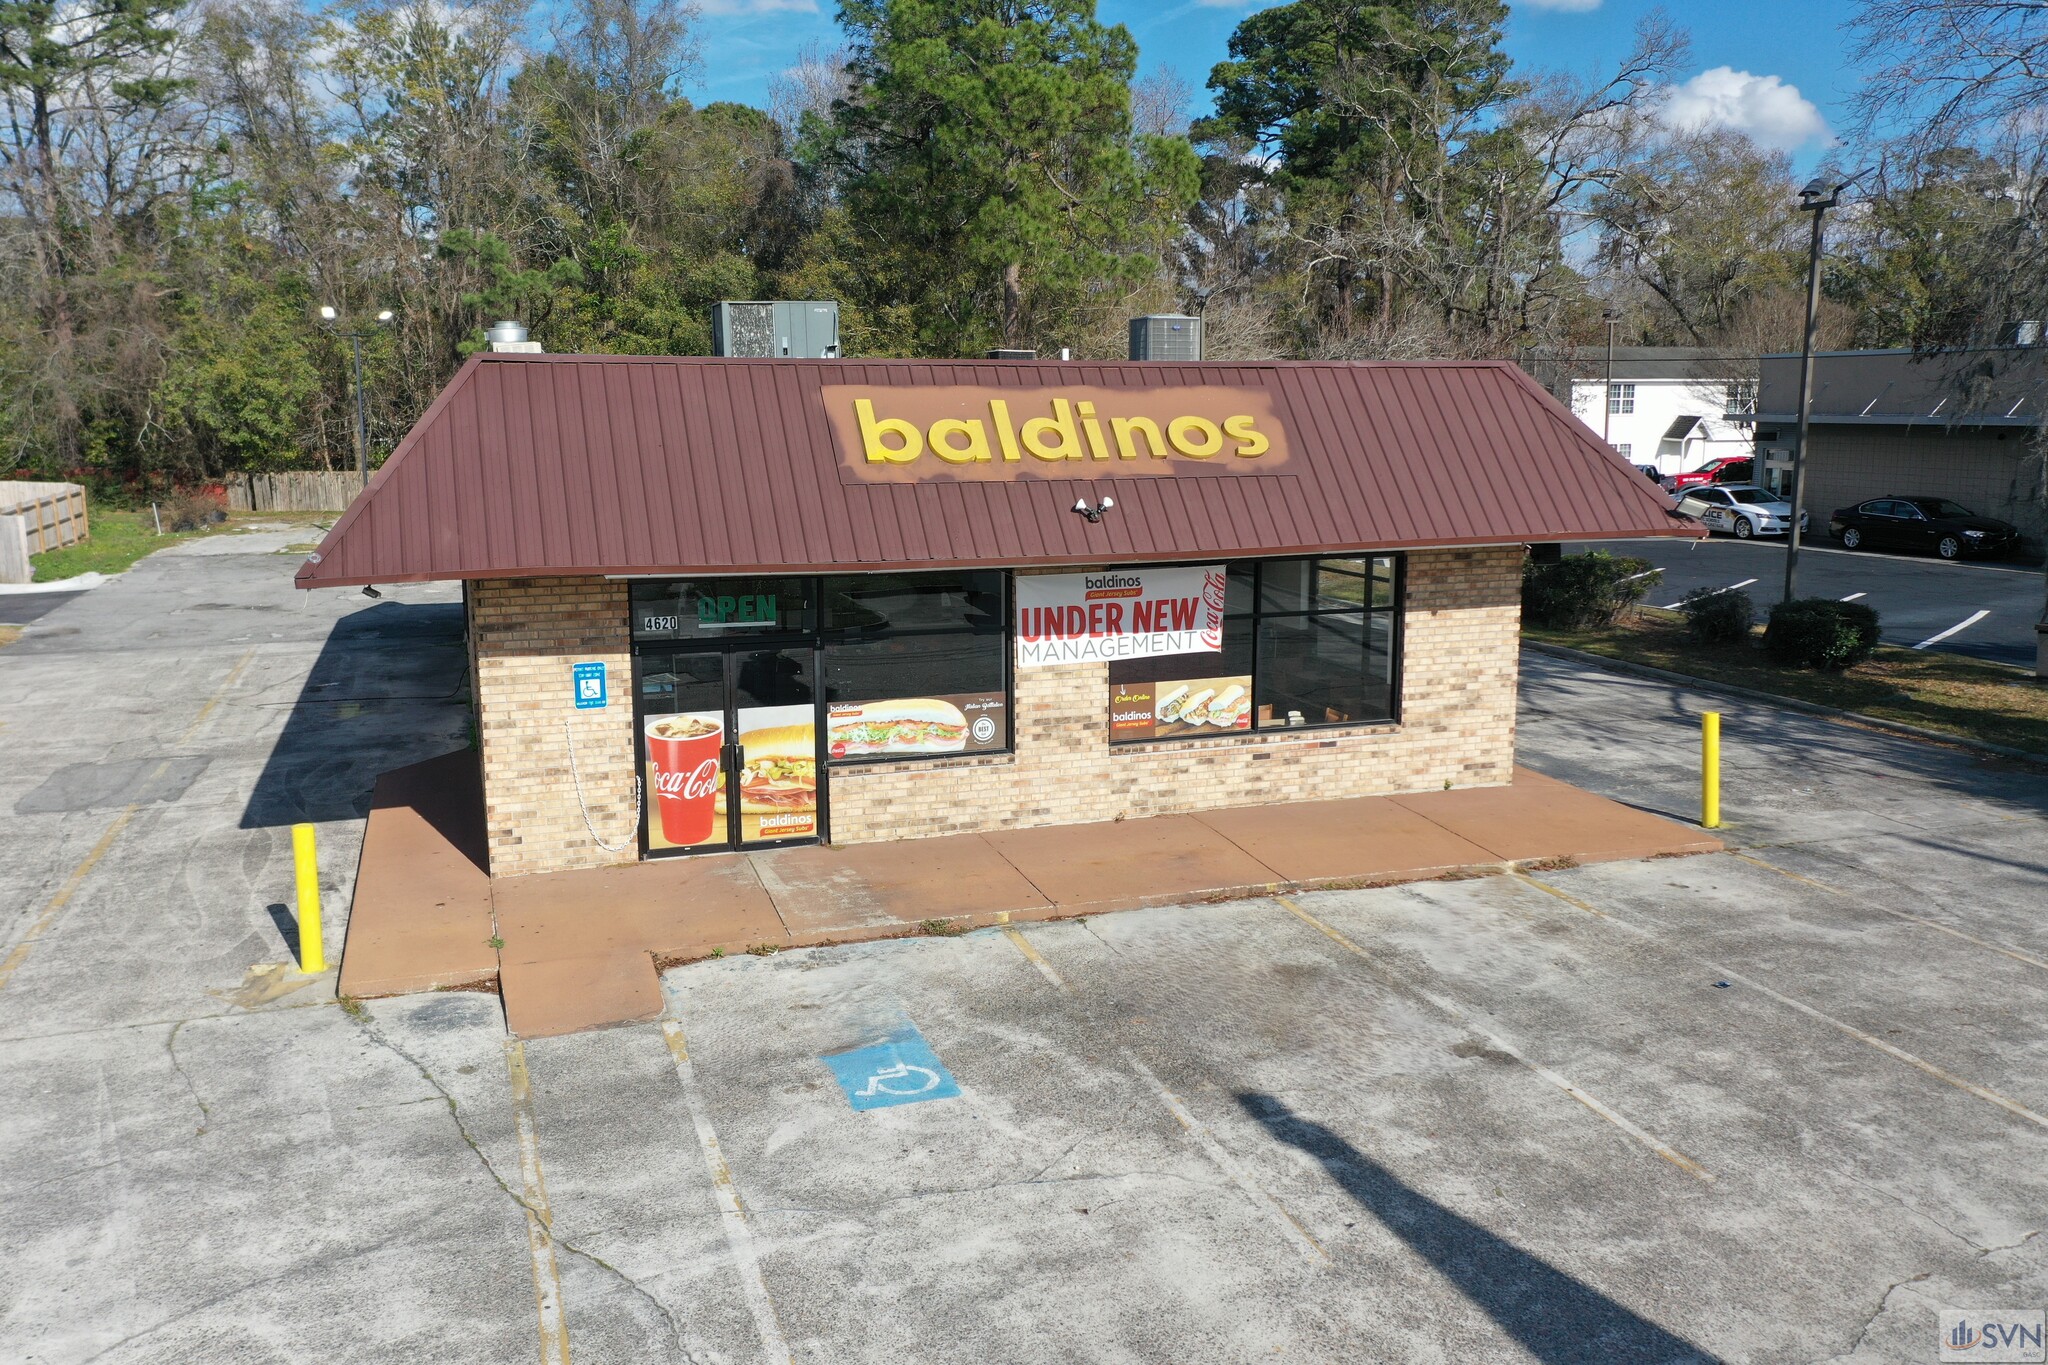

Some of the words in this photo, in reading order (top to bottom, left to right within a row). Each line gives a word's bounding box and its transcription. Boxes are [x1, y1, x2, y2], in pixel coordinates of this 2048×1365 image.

[853, 398, 1270, 464] baldinos
[1085, 575, 1141, 589] baldinos
[1105, 590, 1123, 598] Jersey
[697, 594, 776, 623] OPEN
[1200, 569, 1225, 649] Coca-Cola
[645, 616, 677, 630] 4620
[1021, 602, 1123, 643] UNDER
[1133, 597, 1200, 634] NEW
[1022, 631, 1198, 663] MANAGEMENT
[1113, 711, 1152, 721] baldinos
[760, 814, 811, 826] baldinos
